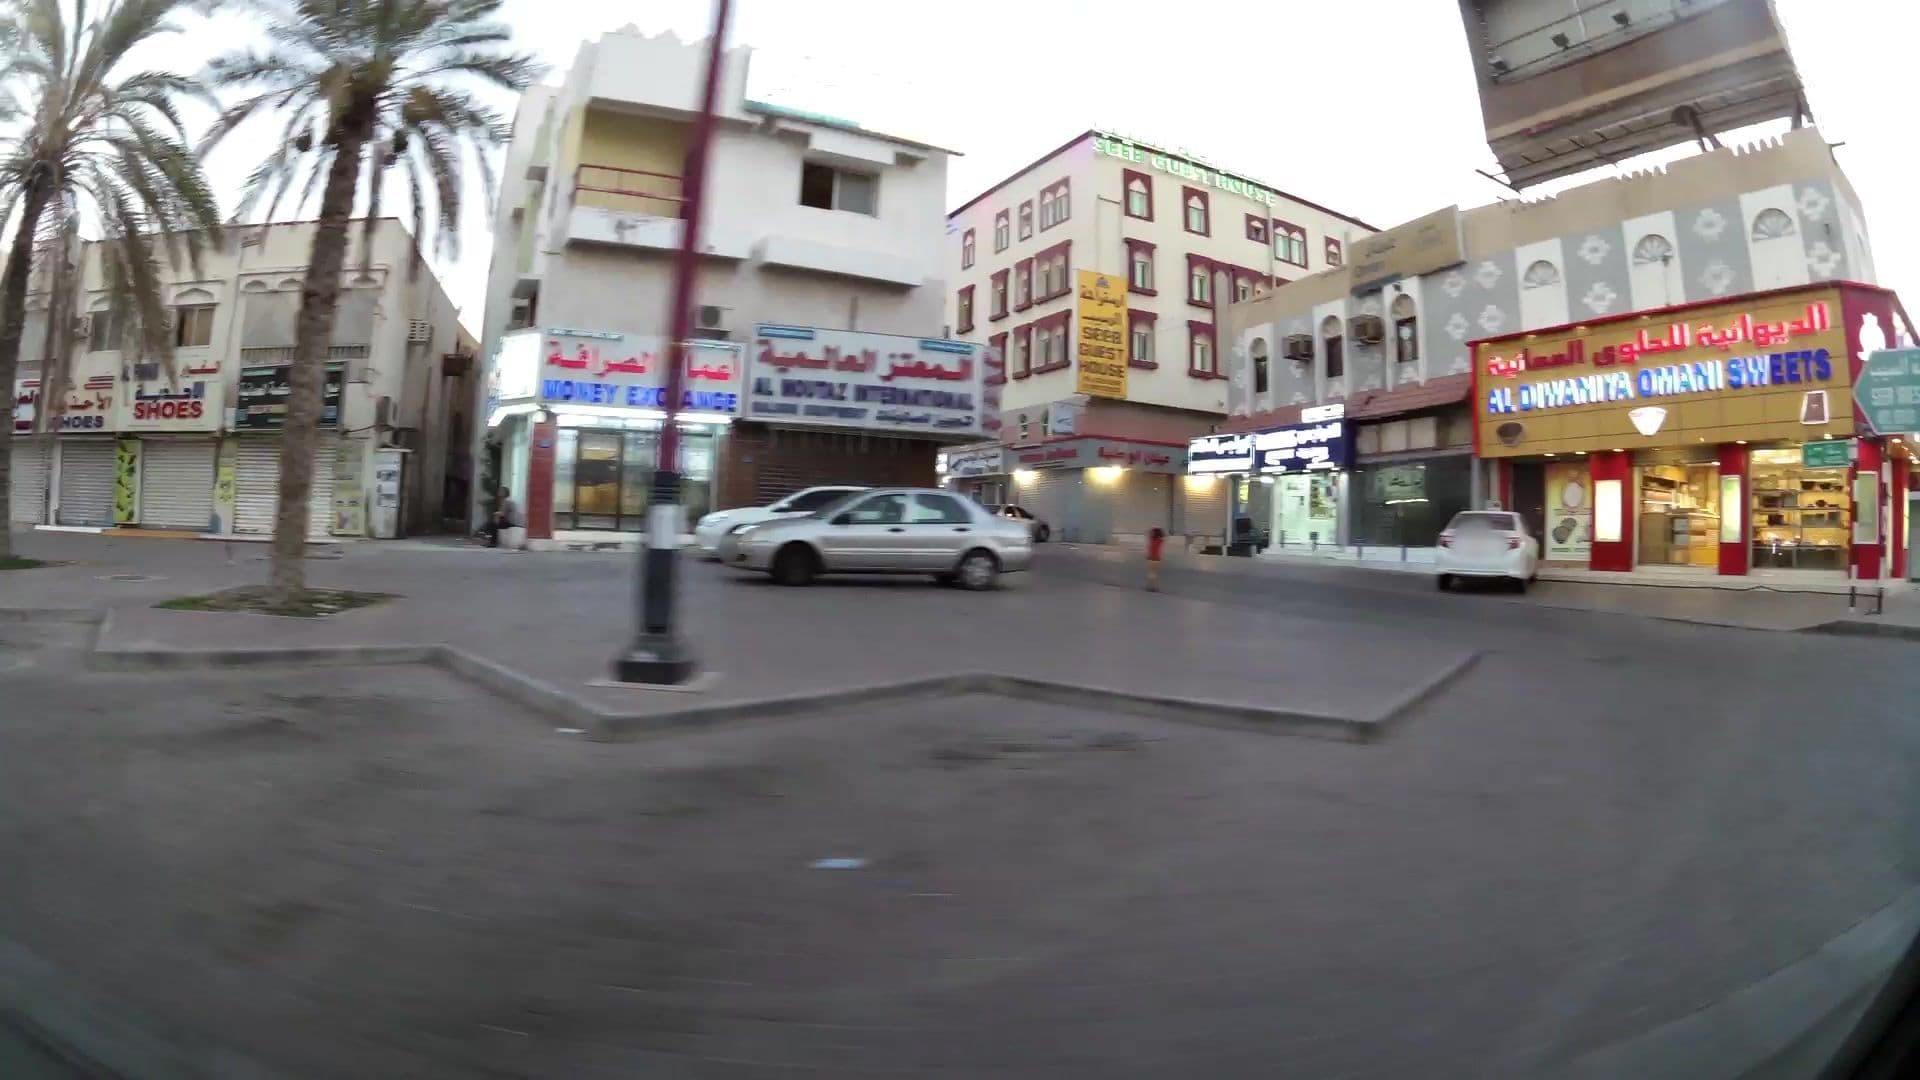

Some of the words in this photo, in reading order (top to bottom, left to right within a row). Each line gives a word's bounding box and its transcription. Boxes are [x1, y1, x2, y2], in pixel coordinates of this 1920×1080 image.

[1082, 326, 1122, 345] SEEB
[1079, 342, 1124, 361] GUEST
[1079, 360, 1124, 378] HOUSE
[1488, 387, 1517, 413] AL
[1519, 371, 1634, 411] DIWANIYA
[1637, 354, 1724, 398] OMANI
[1728, 348, 1832, 389] SWEETS
[544, 380, 619, 404] MONEY
[854, 384, 974, 410] INTERNATIONAL
[133, 401, 204, 420] SHOES
